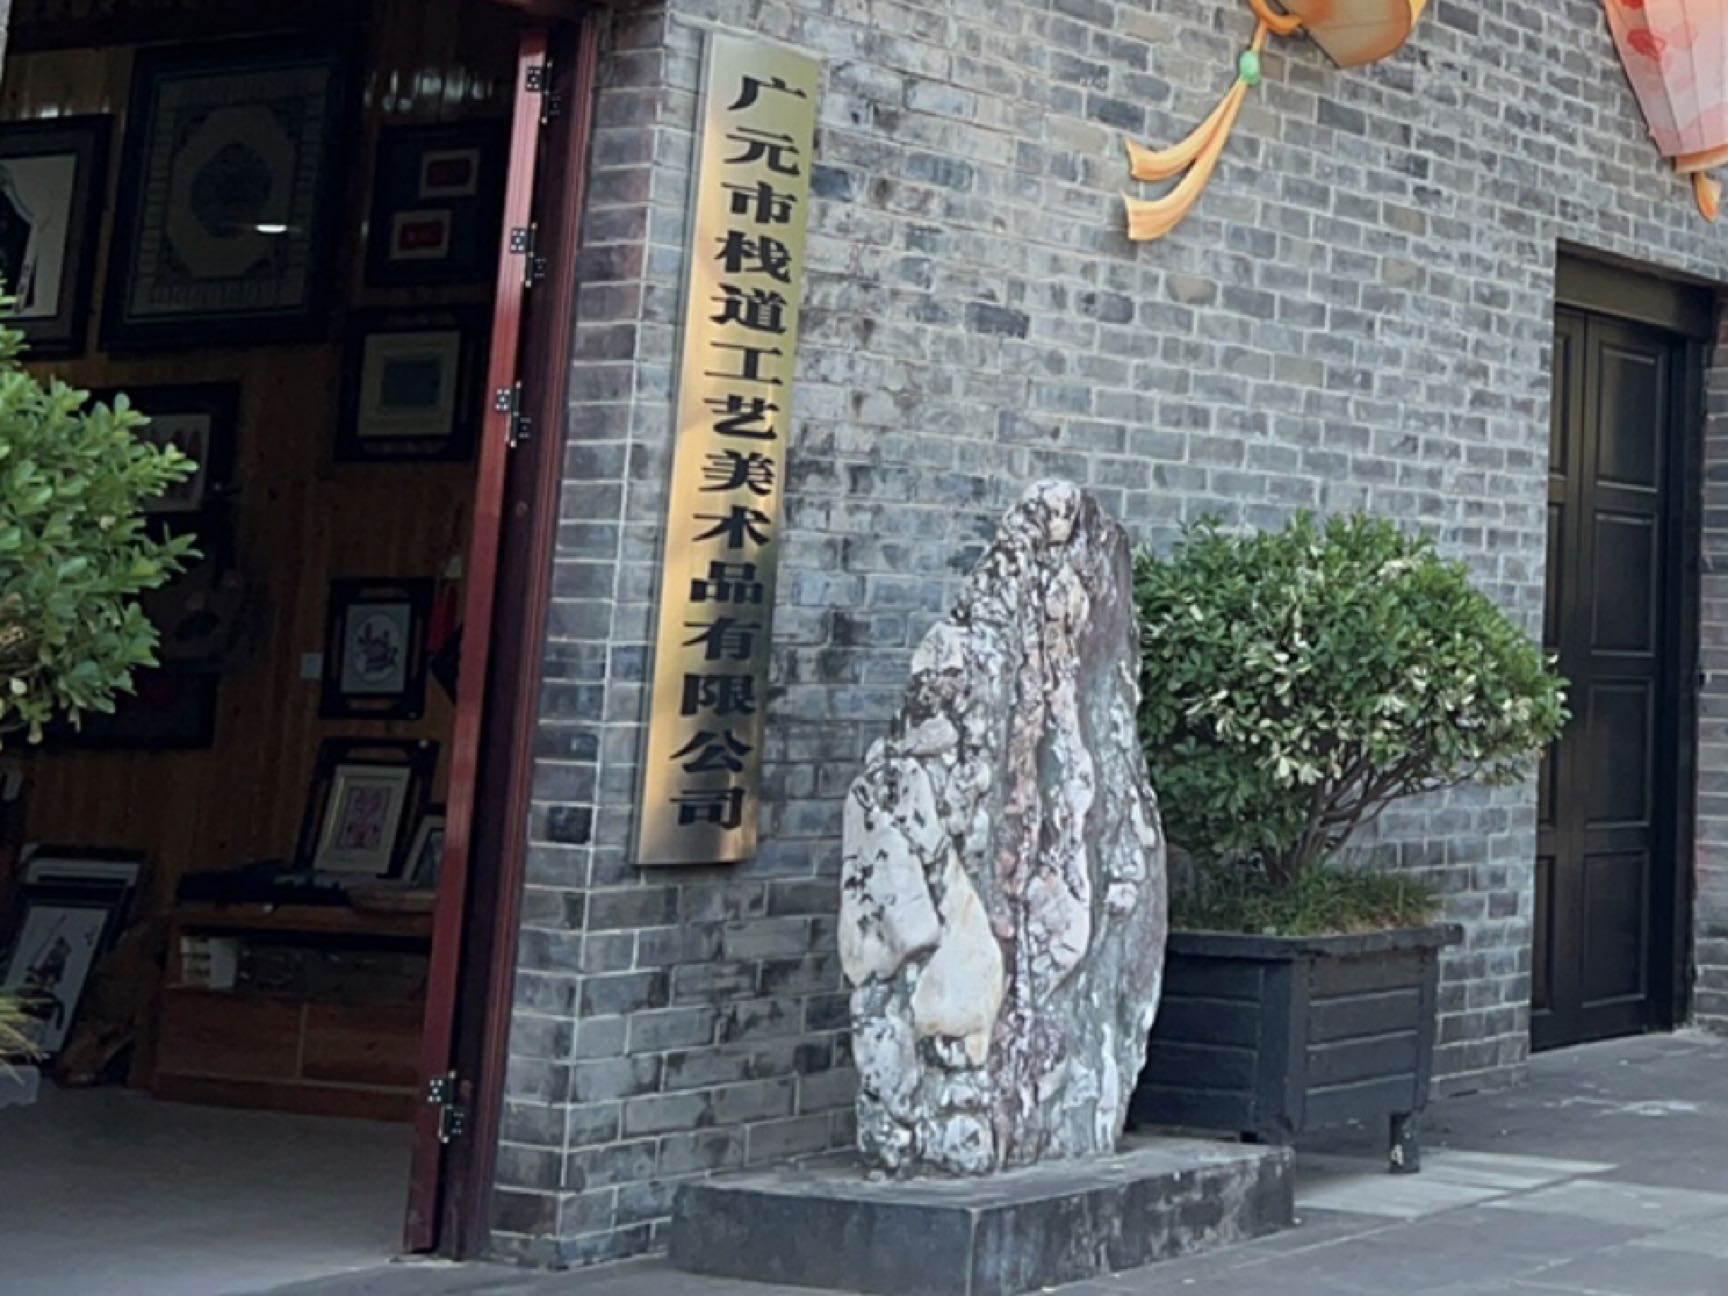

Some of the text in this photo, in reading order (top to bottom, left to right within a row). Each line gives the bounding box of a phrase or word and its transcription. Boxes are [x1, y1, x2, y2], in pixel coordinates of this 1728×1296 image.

[668, 75, 808, 831] 广元市栈道工艺美术品有限公司
